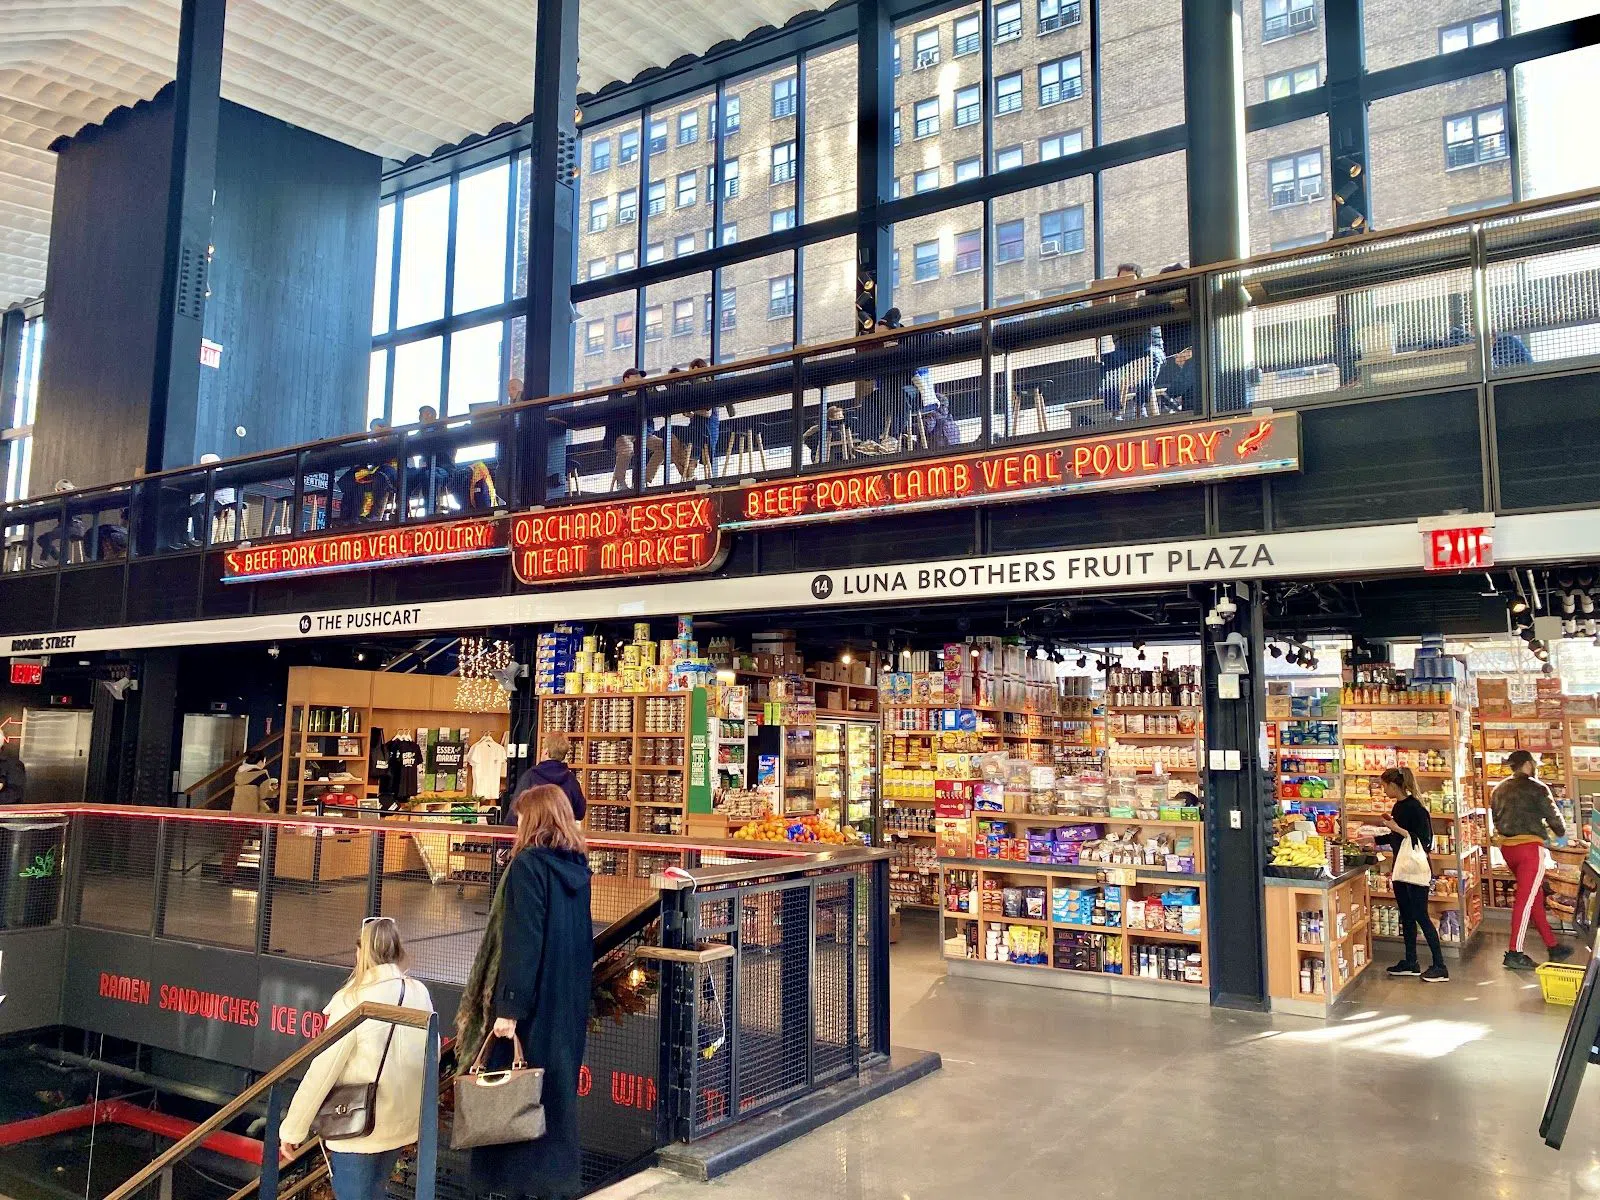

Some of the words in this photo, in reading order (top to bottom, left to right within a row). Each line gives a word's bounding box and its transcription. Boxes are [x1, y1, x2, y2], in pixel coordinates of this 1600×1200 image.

[748, 485, 805, 516] BEEF
[816, 474, 881, 508] PORK
[893, 463, 968, 499] LAMB
[982, 452, 1060, 488] VEAL
[1074, 430, 1219, 479] POULTRY
[515, 511, 618, 545] ORCHARD
[630, 499, 705, 533] ESSEX
[245, 549, 277, 572] BEEF
[282, 544, 317, 568] PORK
[322, 539, 362, 563] LAMB
[368, 534, 407, 558] VEAL
[413, 525, 486, 551] POULTRY
[523, 545, 585, 576] MEAT
[601, 534, 701, 569] MARKET
[1432, 528, 1483, 567] EXIT
[814, 579, 829, 594] 14
[843, 571, 908, 595] LUNA
[918, 559, 1056, 590] BROTHERS
[1068, 552, 1154, 579] FRUIT
[1167, 543, 1275, 573] PLAZA
[300, 619, 309, 630] 16
[317, 615, 342, 630] THE
[347, 609, 421, 629] PUSHCART
[45, 635, 77, 649] STREET
[435, 754, 461, 763] MARKET
[436, 745, 456, 755] ESSEX
[99, 972, 150, 1005] RAMEN
[158, 984, 259, 1028] SANDWICHES
[271, 1004, 297, 1035] ICE
